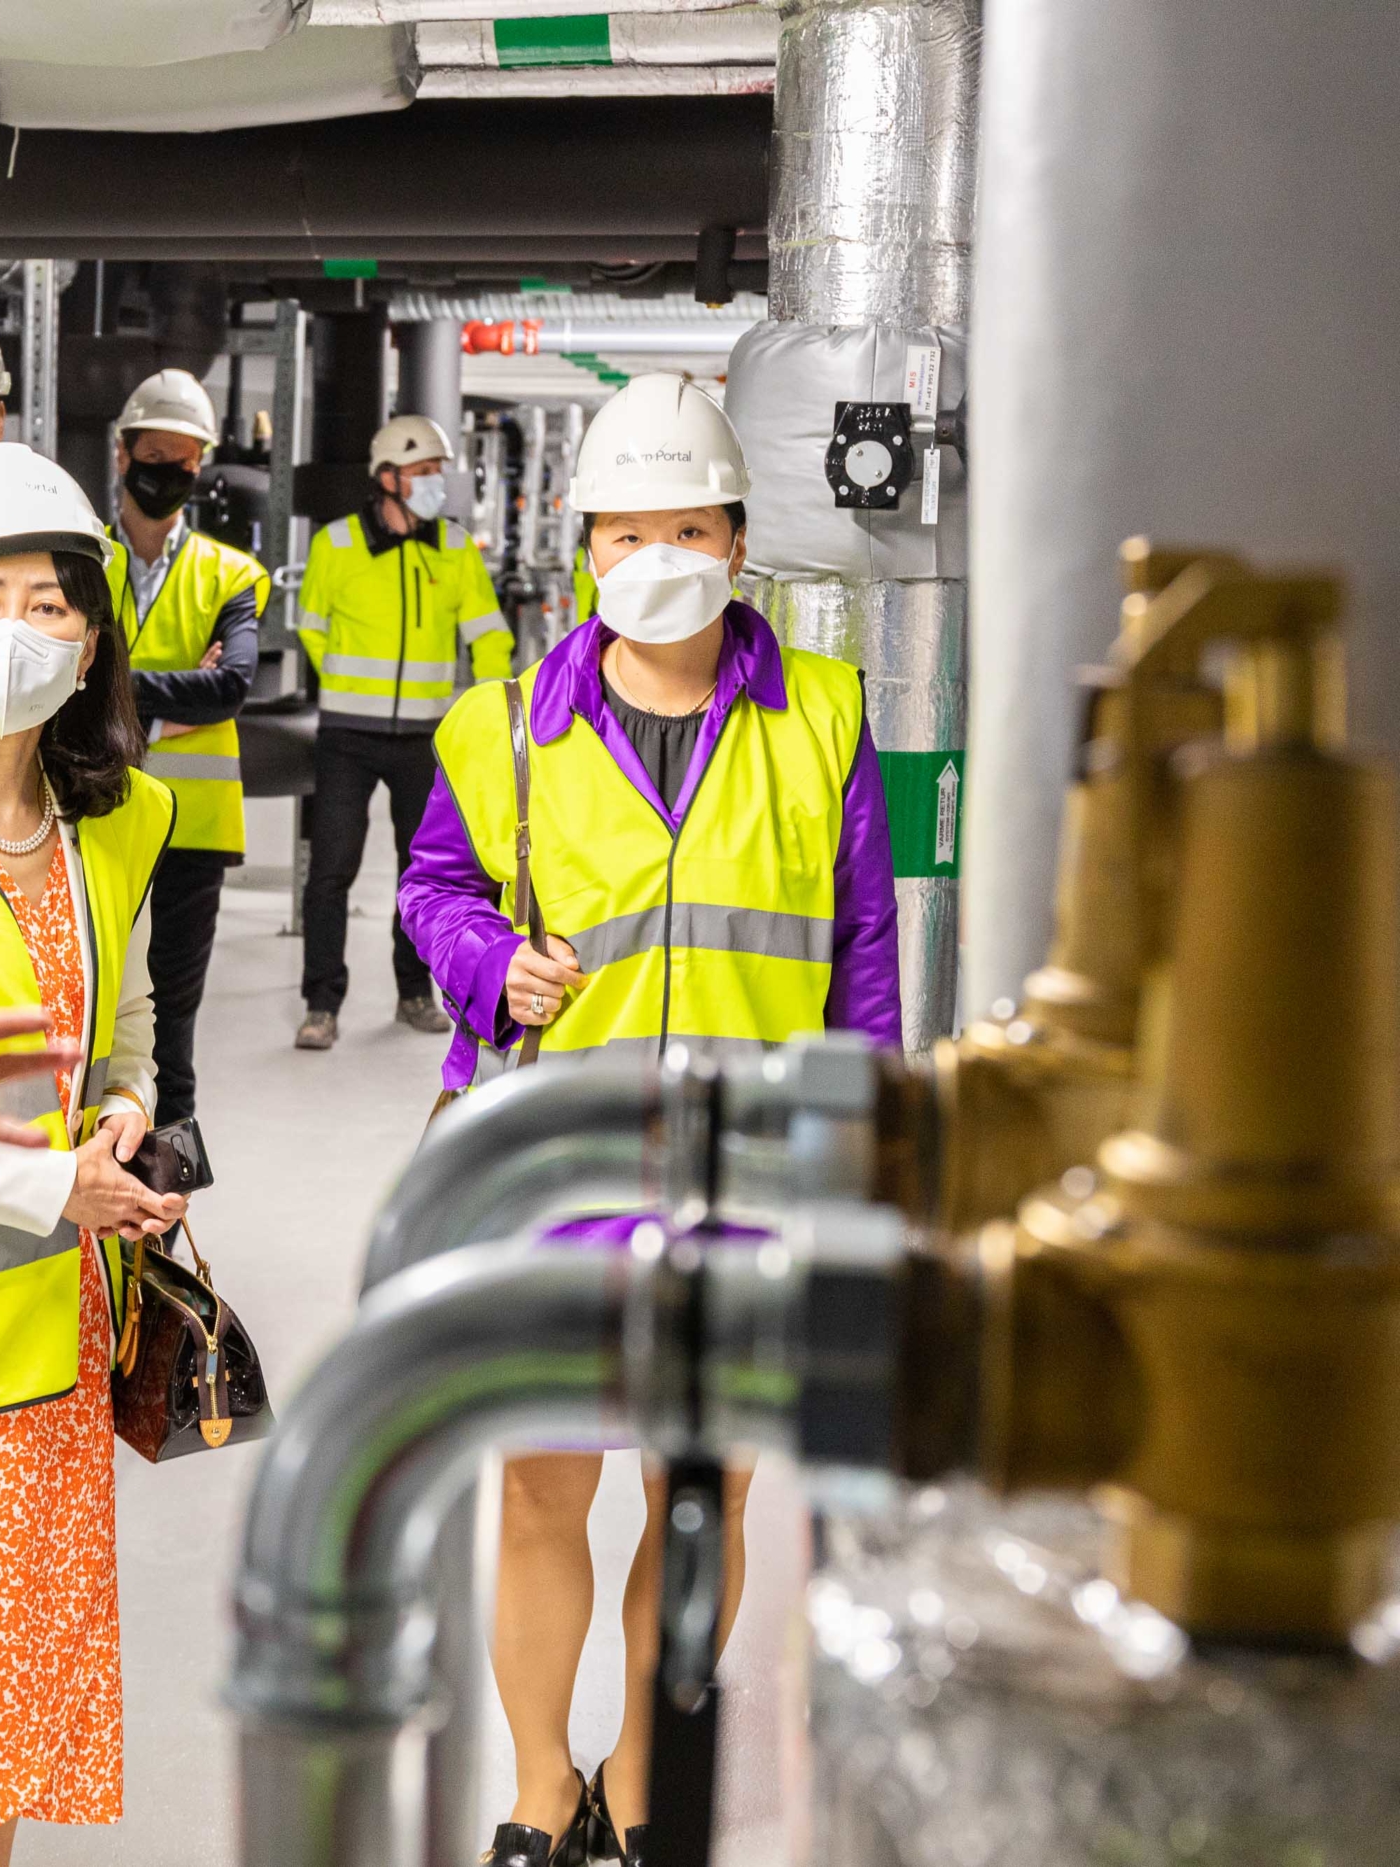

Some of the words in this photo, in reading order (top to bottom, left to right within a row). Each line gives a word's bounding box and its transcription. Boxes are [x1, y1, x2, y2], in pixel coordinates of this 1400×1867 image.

[616, 453, 653, 465] Økrn
[655, 450, 692, 462] Portal
[938, 819, 946, 848] VARME
